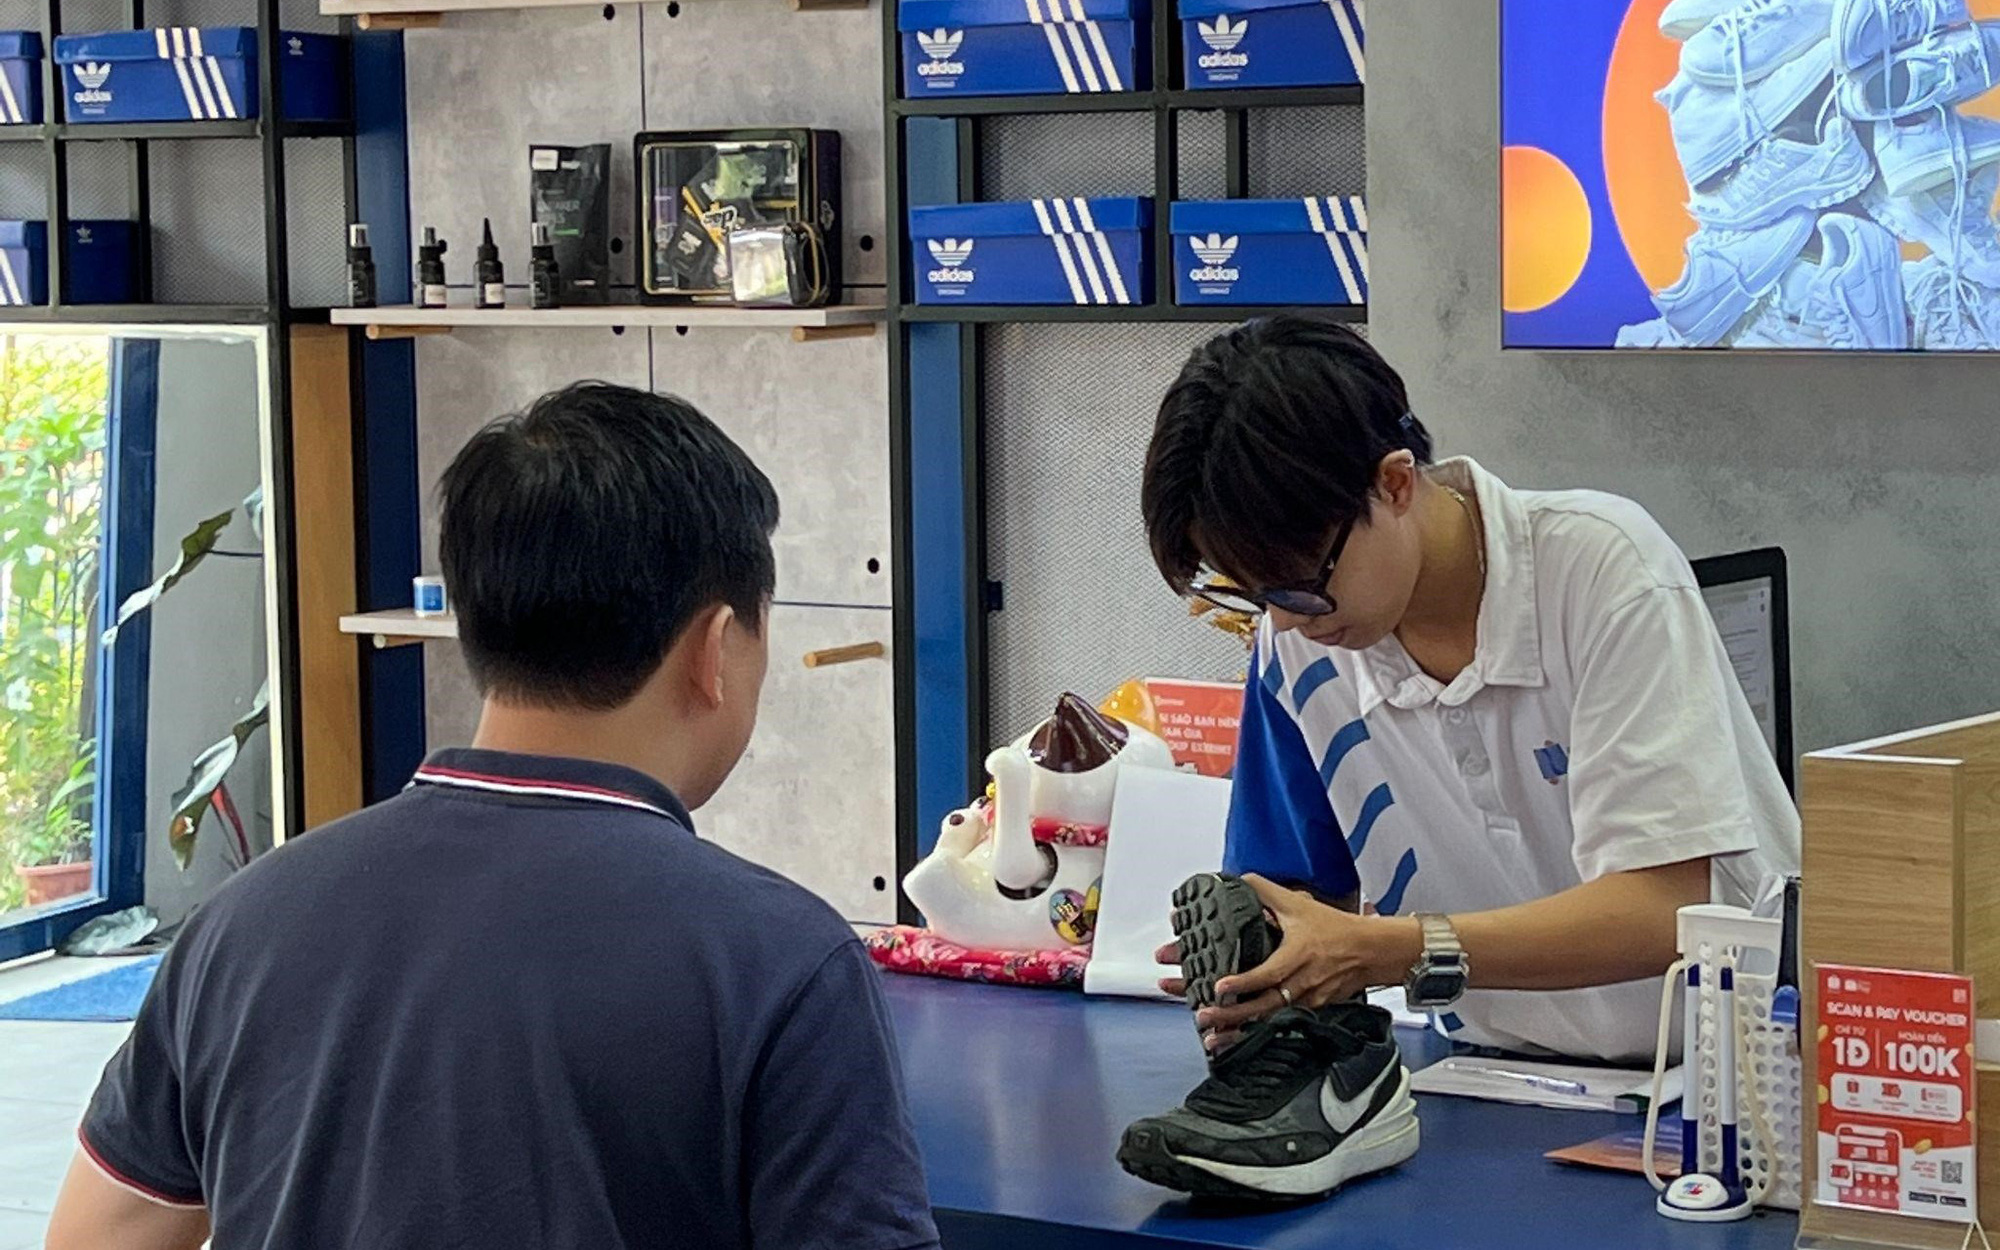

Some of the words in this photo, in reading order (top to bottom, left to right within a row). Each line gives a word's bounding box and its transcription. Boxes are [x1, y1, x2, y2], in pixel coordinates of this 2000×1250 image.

[1198, 51, 1249, 68] adidas
[917, 60, 964, 76] adidas
[928, 267, 974, 283] adidas
[1189, 266, 1239, 281] adidas
[1826, 1001, 1862, 1018] SCAN
[1864, 1005, 1874, 1018] &
[1876, 1006, 1900, 1020] PAY
[1903, 1008, 1967, 1027] VOUCHER
[1884, 1041, 1961, 1078] 100K
